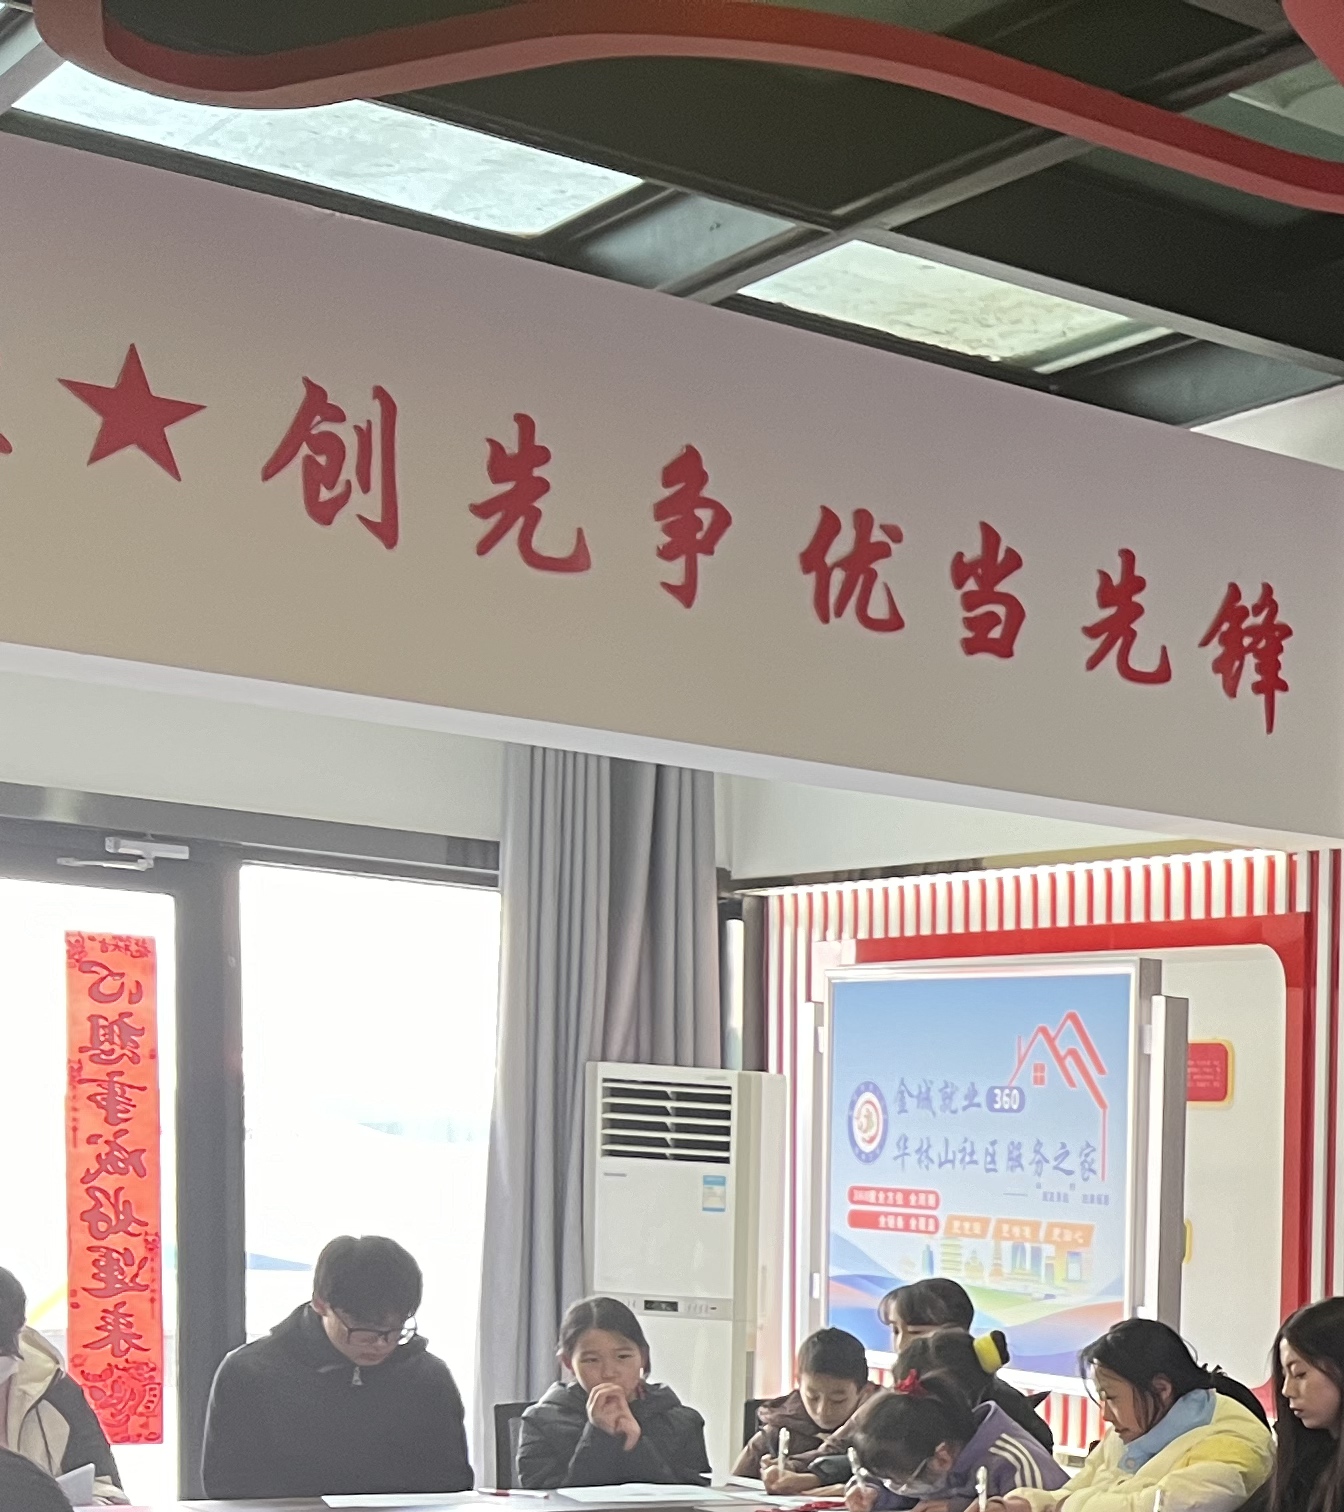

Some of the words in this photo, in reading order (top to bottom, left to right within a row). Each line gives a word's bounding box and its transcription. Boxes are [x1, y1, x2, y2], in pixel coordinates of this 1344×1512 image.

[260, 375, 1294, 736] 创先争优当先锋
[992, 1088, 1020, 1110] 360
[893, 1134, 1098, 1182] 华林山社区服务之家
